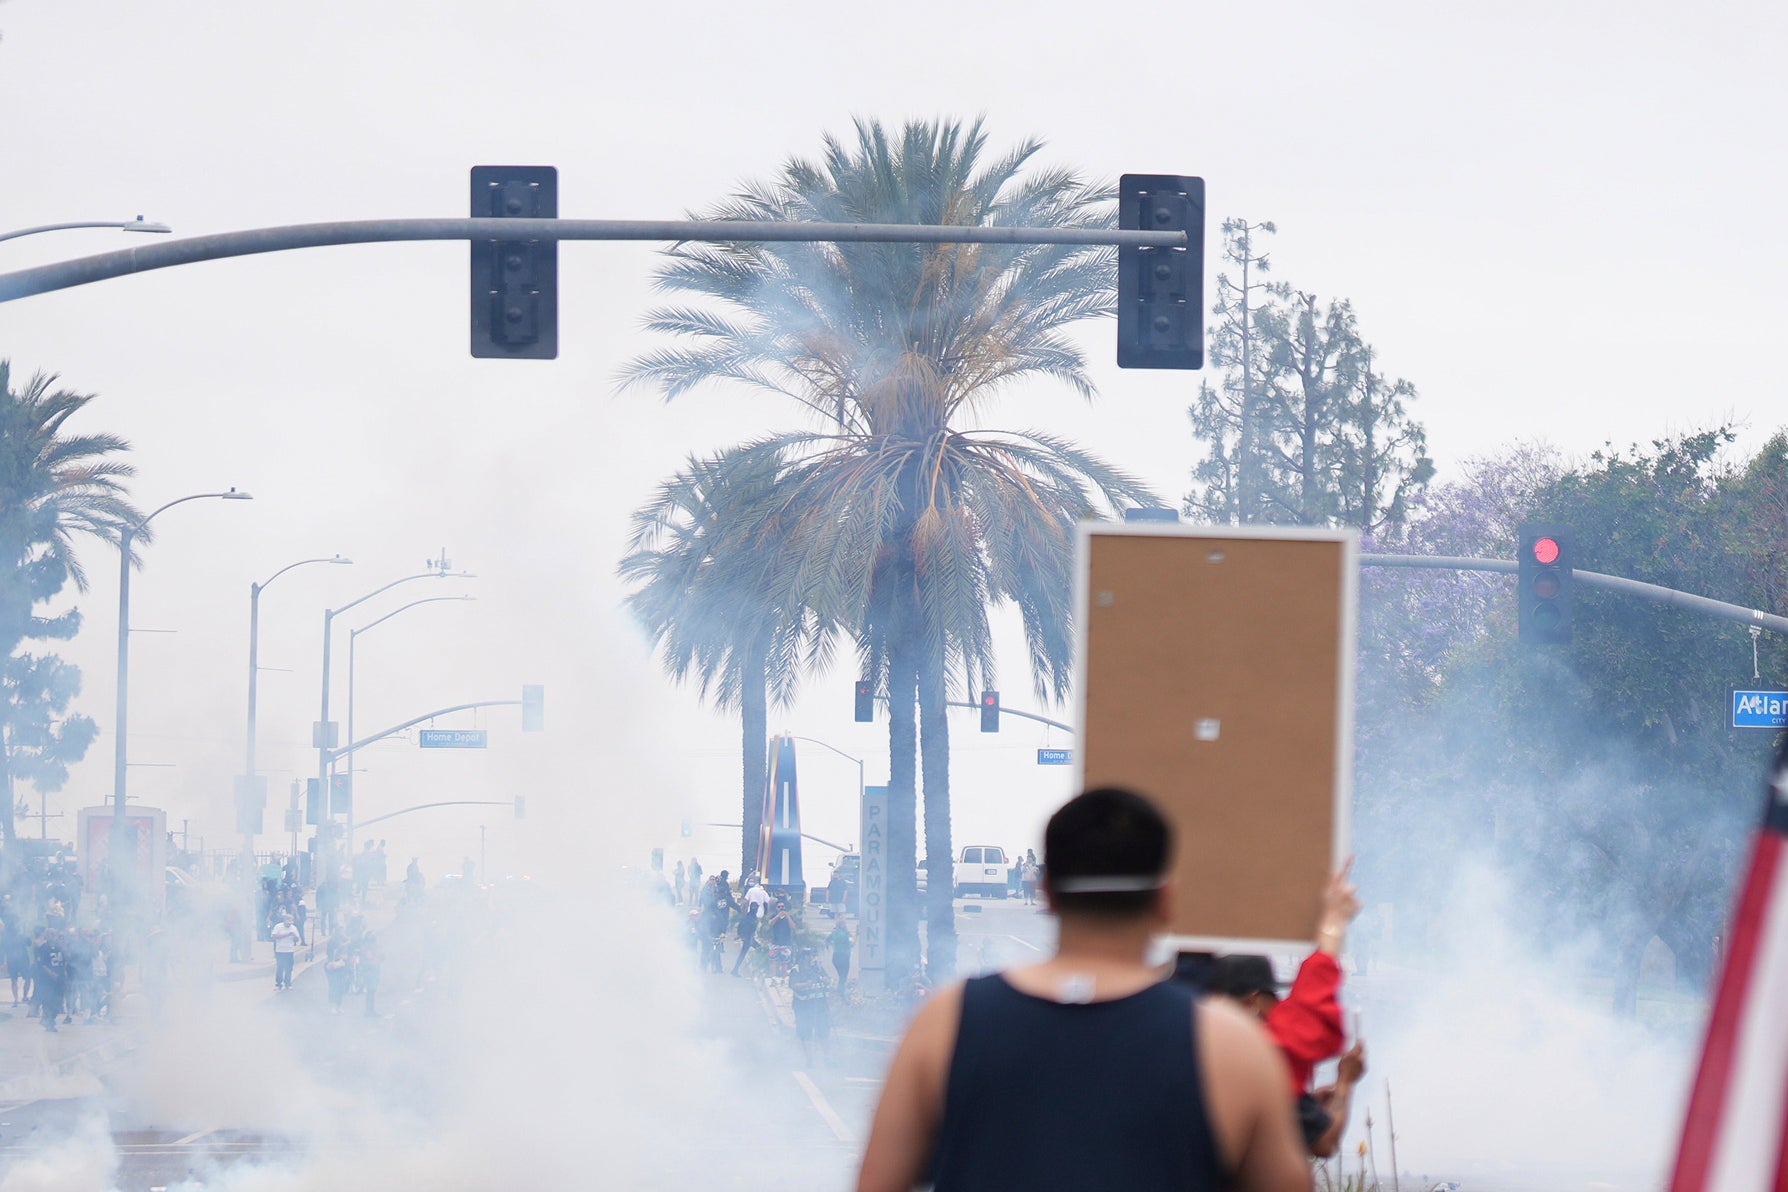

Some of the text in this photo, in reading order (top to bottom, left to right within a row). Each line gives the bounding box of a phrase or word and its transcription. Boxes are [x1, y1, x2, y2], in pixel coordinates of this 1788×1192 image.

[427, 733, 479, 743] Home Depot
[1043, 751, 1065, 759] Home
[866, 805, 881, 959] PARAMOUNT
